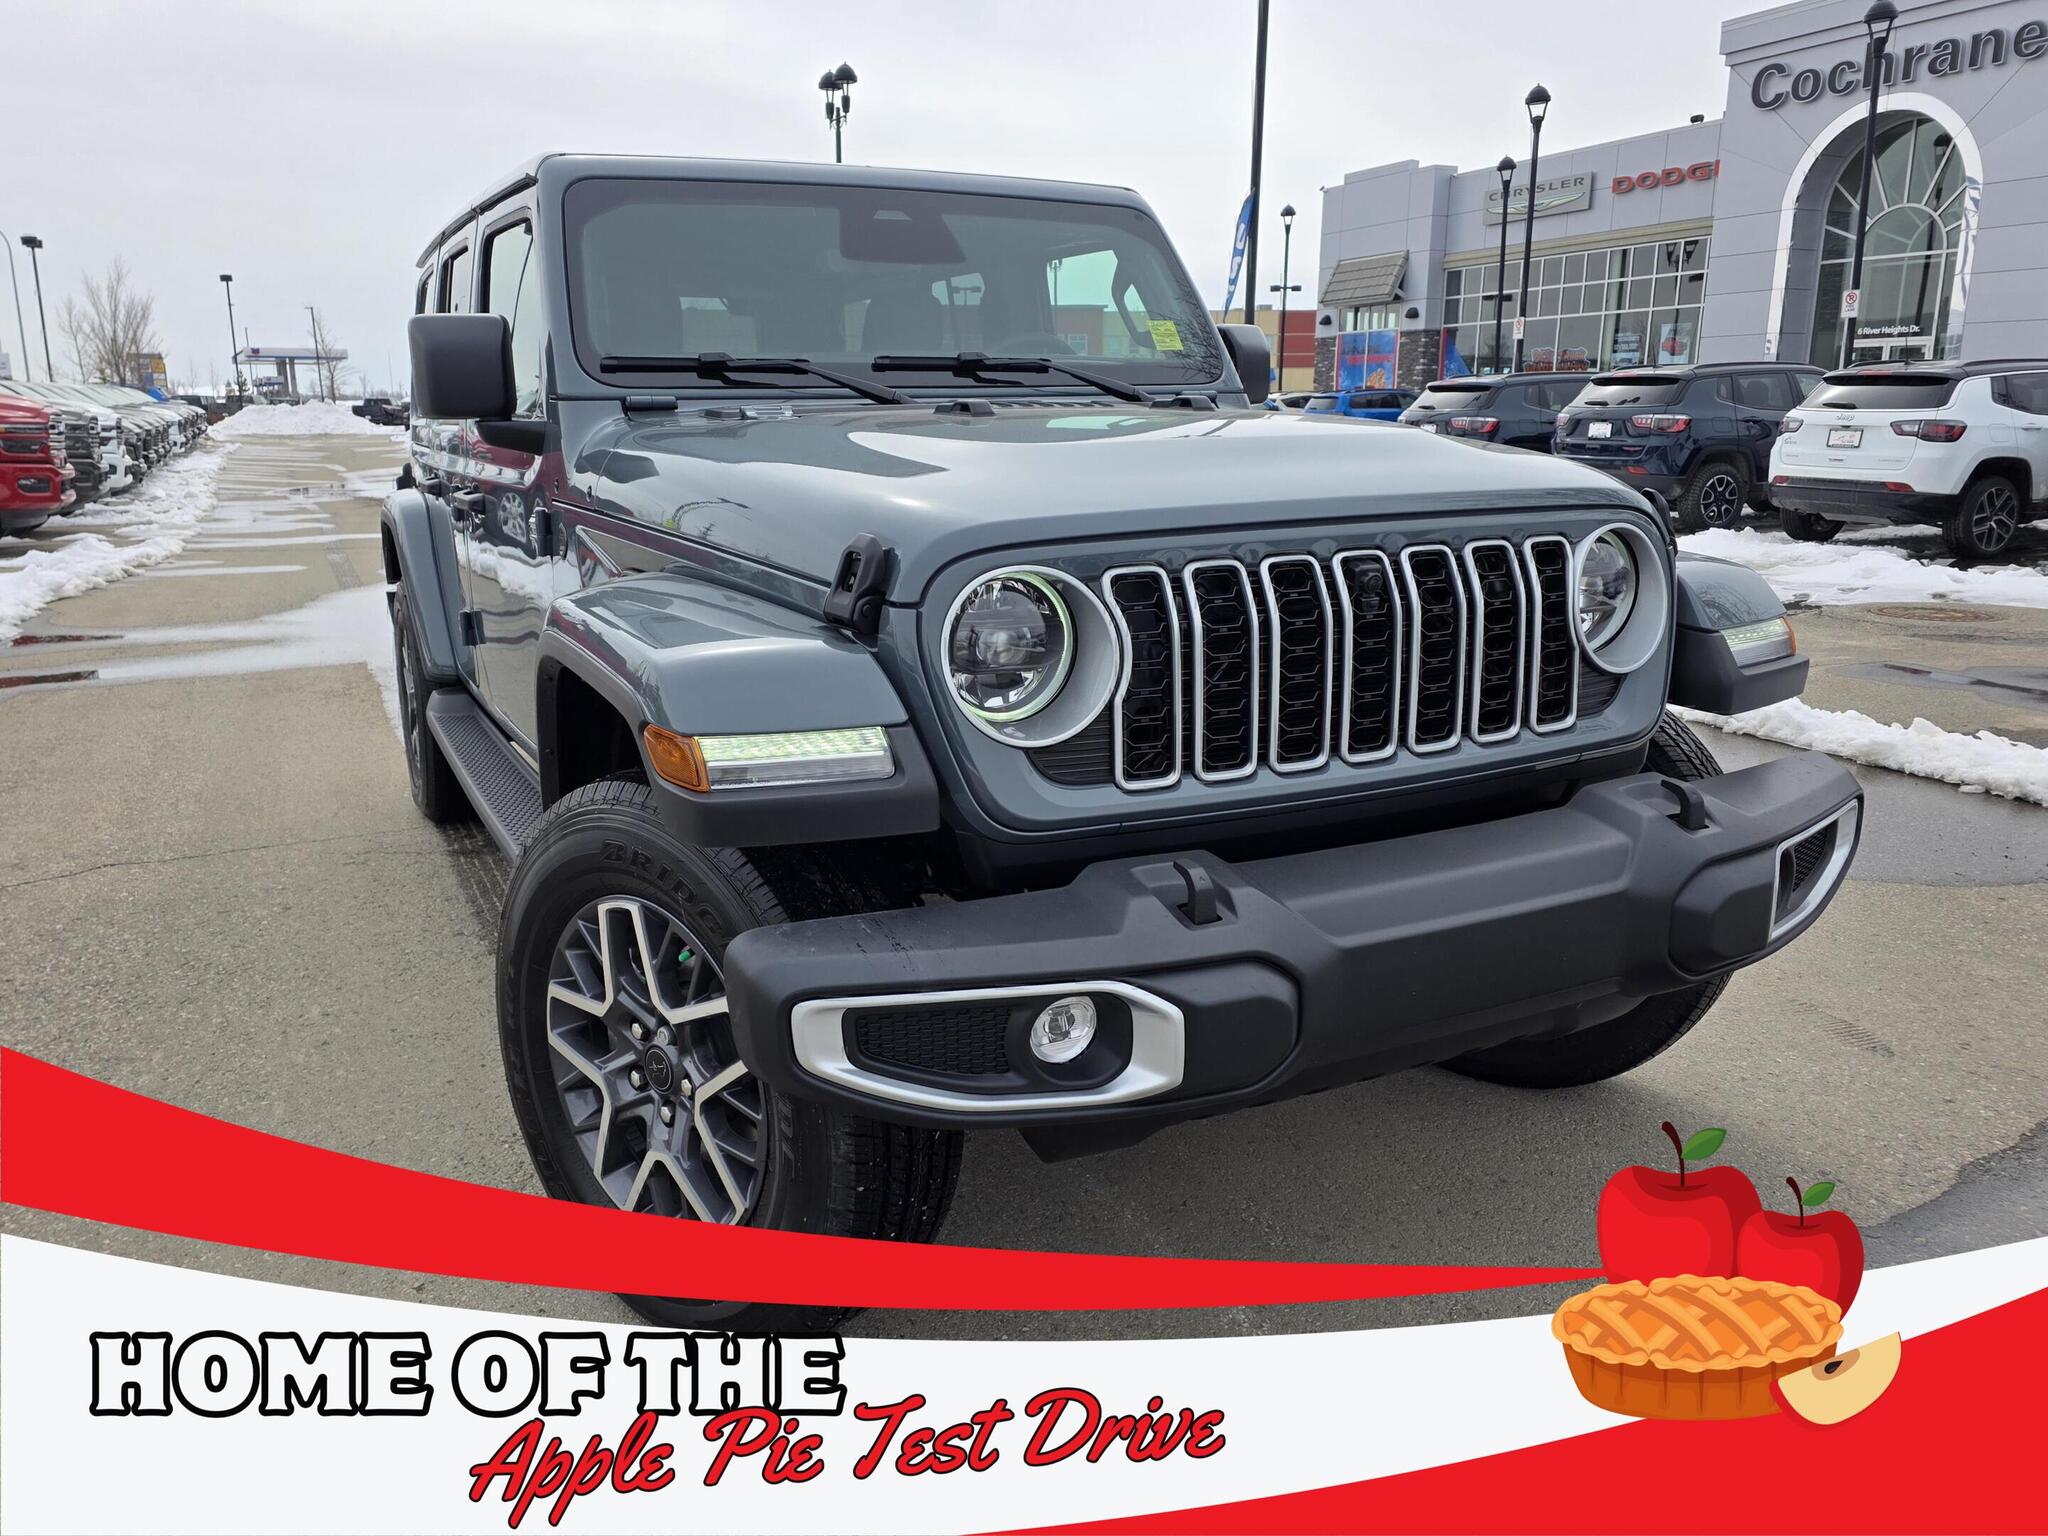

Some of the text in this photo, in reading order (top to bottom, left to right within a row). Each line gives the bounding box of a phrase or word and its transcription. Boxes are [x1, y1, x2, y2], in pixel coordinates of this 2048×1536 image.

[1751, 19, 2048, 110] Cochrane
[1857, 327, 1863, 335] 6
[1863, 326, 1881, 335] River
[1881, 325, 1909, 335] Heights
